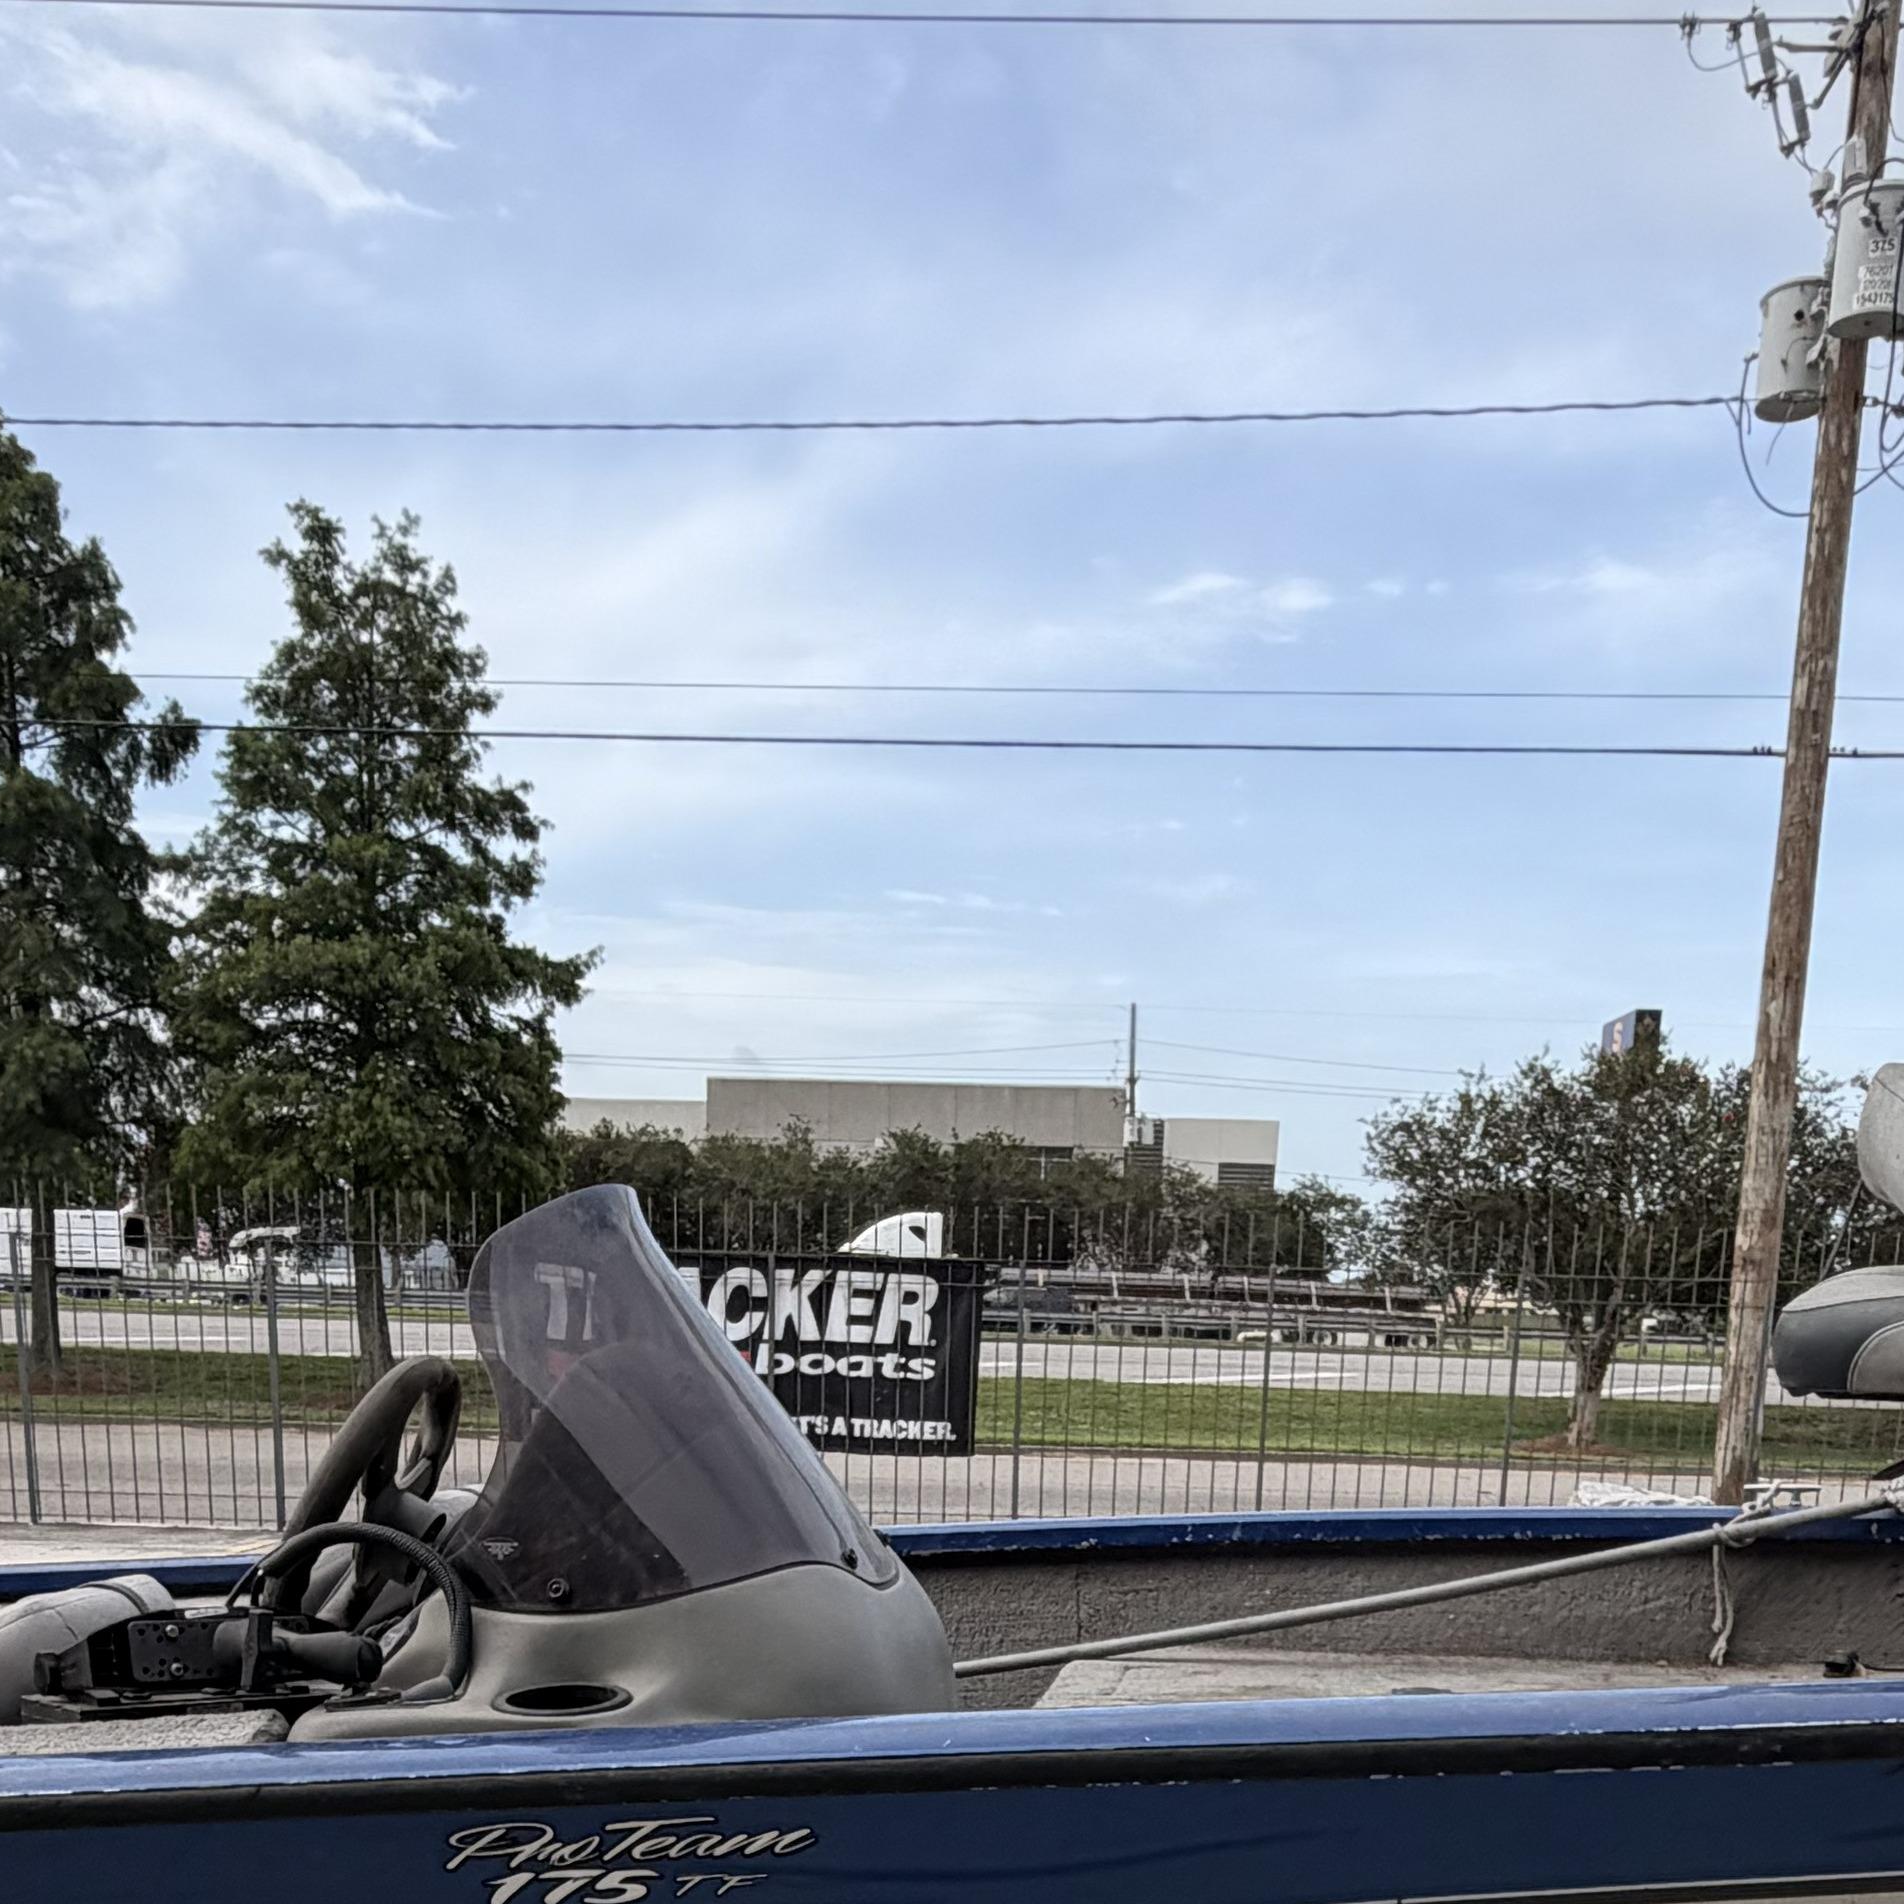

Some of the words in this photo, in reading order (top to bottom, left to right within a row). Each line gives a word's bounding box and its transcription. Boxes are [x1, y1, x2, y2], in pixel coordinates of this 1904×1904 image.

[755, 1343, 936, 1380] boats
[790, 1415, 829, 1436] T'S
[831, 1416, 847, 1436] A
